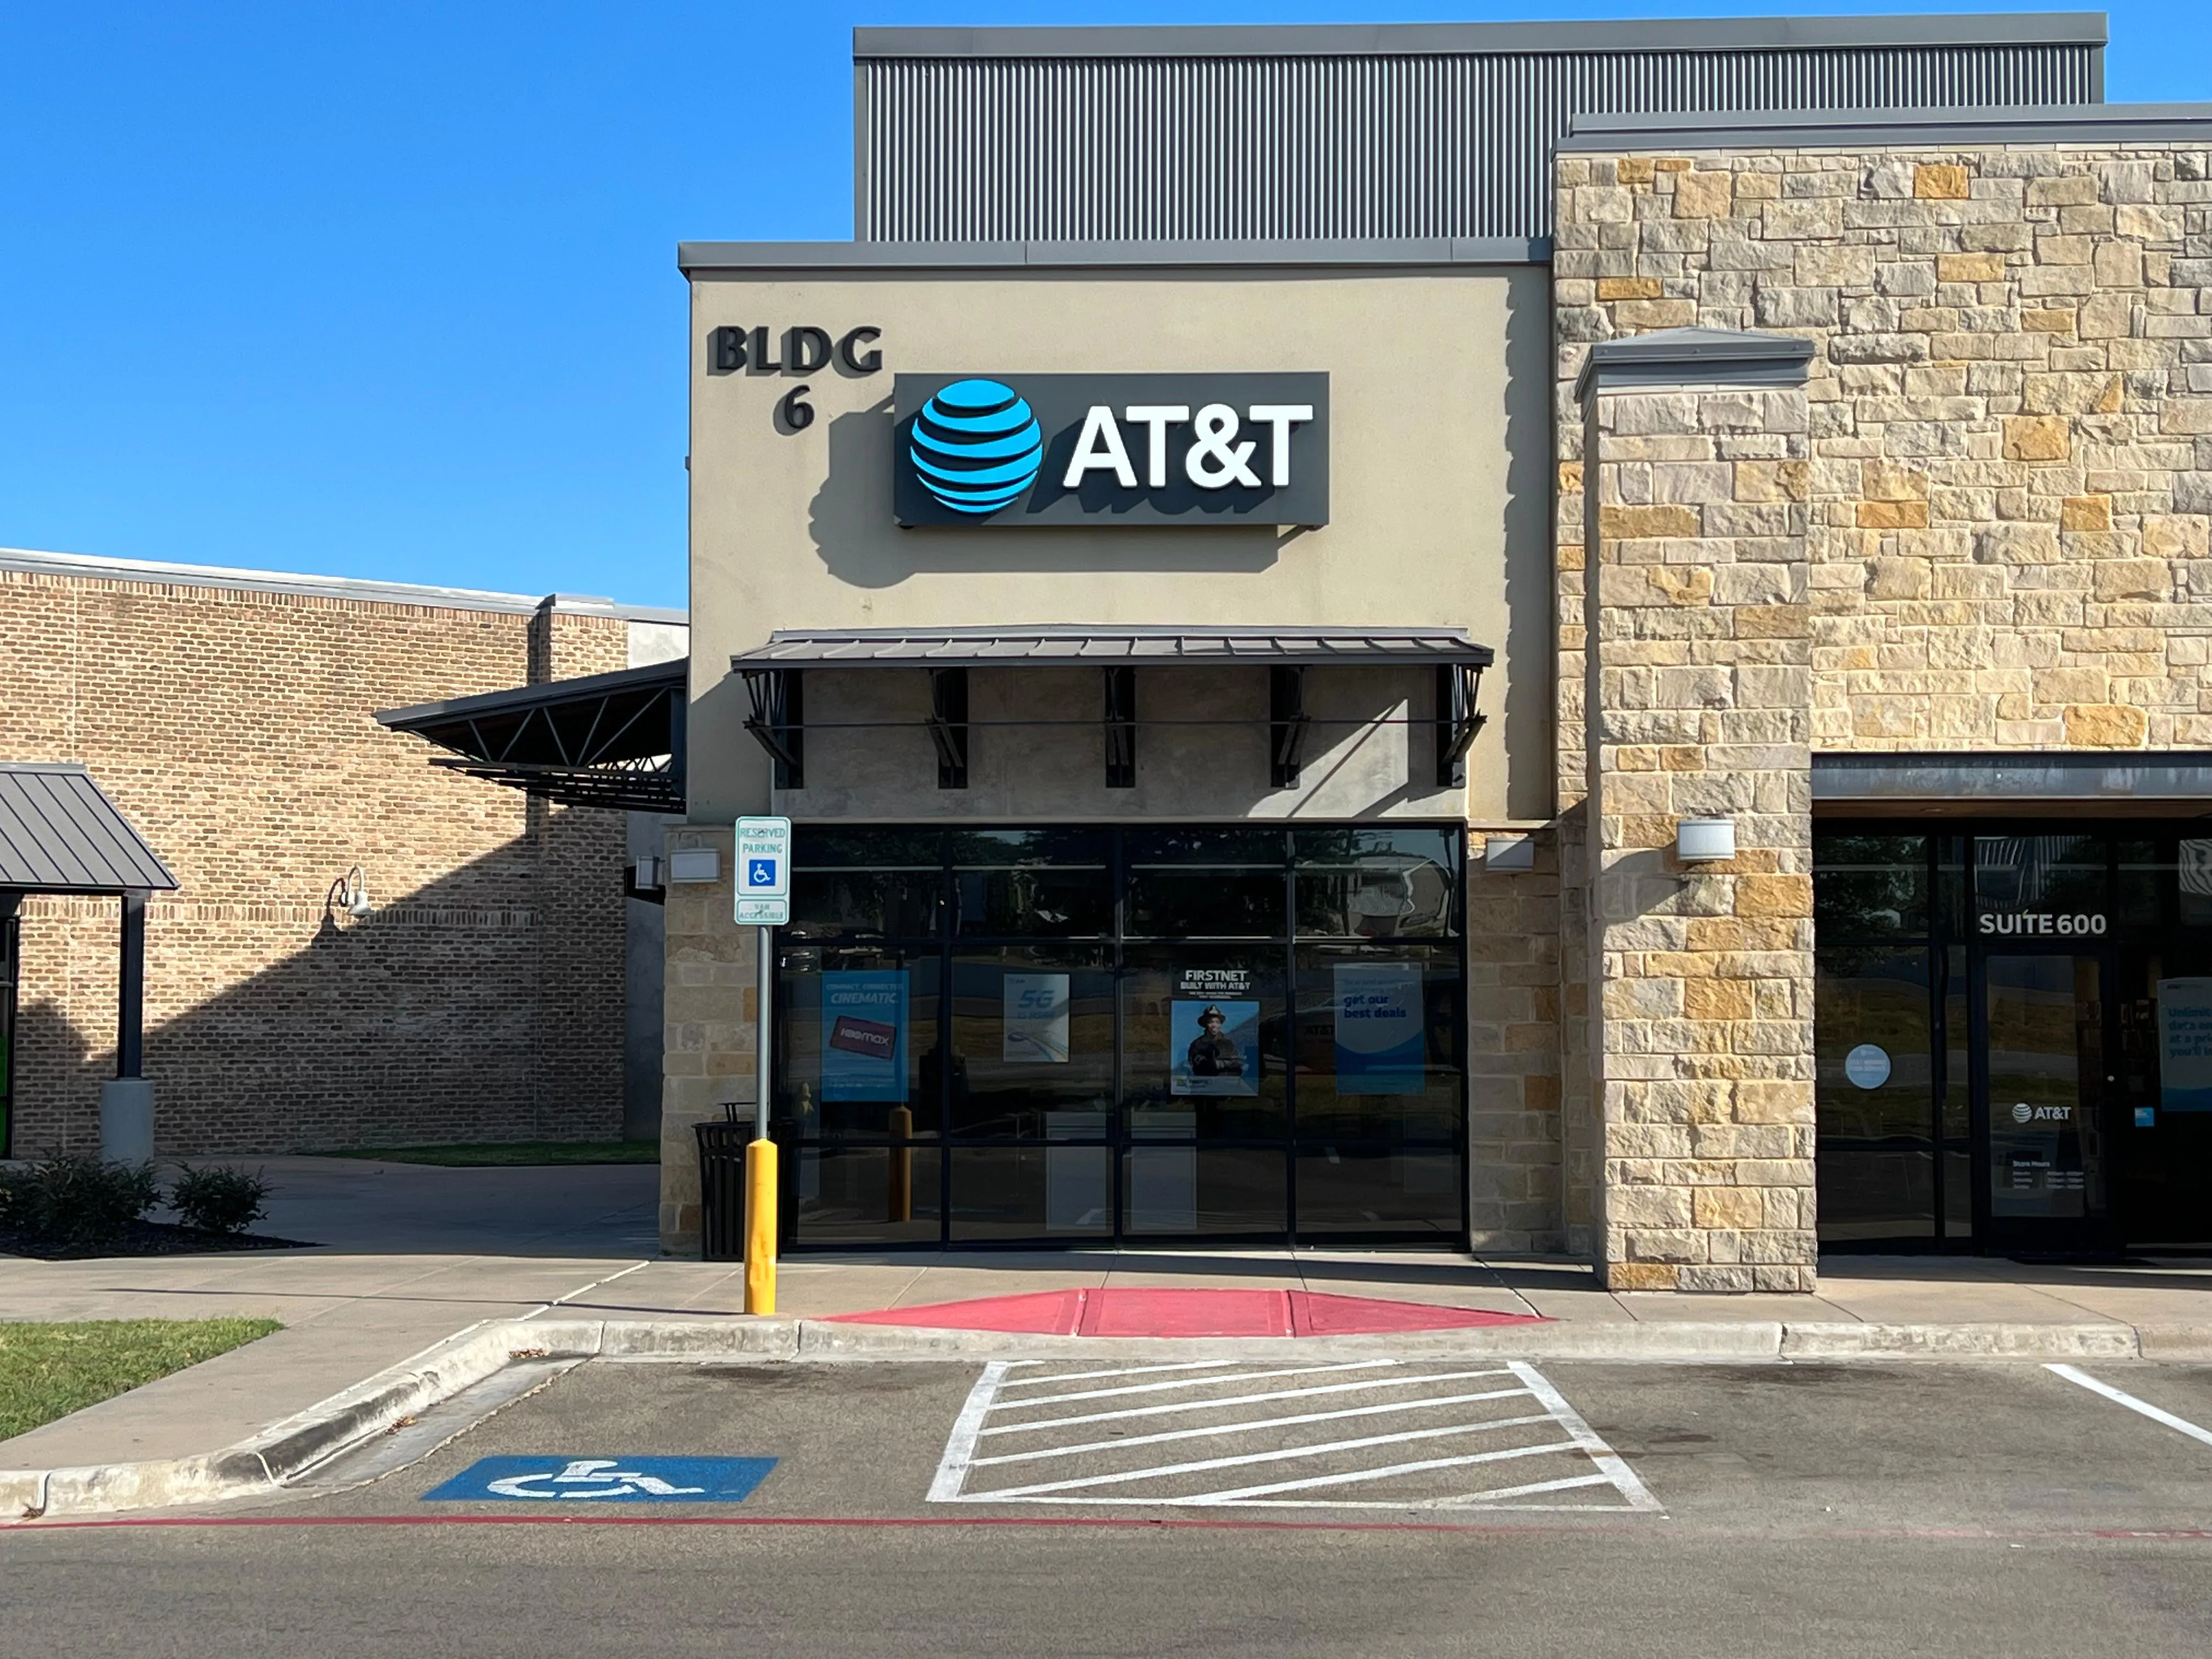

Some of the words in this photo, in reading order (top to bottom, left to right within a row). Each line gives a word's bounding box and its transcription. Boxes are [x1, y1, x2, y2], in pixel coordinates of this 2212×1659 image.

[715, 326, 882, 371] BLDG
[784, 385, 814, 429] 6
[1063, 404, 1313, 489] AT&T
[740, 827, 786, 838] RESERVED
[742, 843, 782, 854] PARKING
[1979, 913, 2053, 934] SUITE
[2057, 913, 2106, 934] 600
[1185, 970, 1249, 981] FIRSTNET
[1228, 981, 1251, 990] AT&T
[1018, 990, 1055, 1008] 5G
[1344, 996, 1364, 1007] get
[1344, 1008, 1371, 1018] best
[1374, 1007, 1407, 1018] deals
[2034, 1107, 2072, 1120] AT&T
